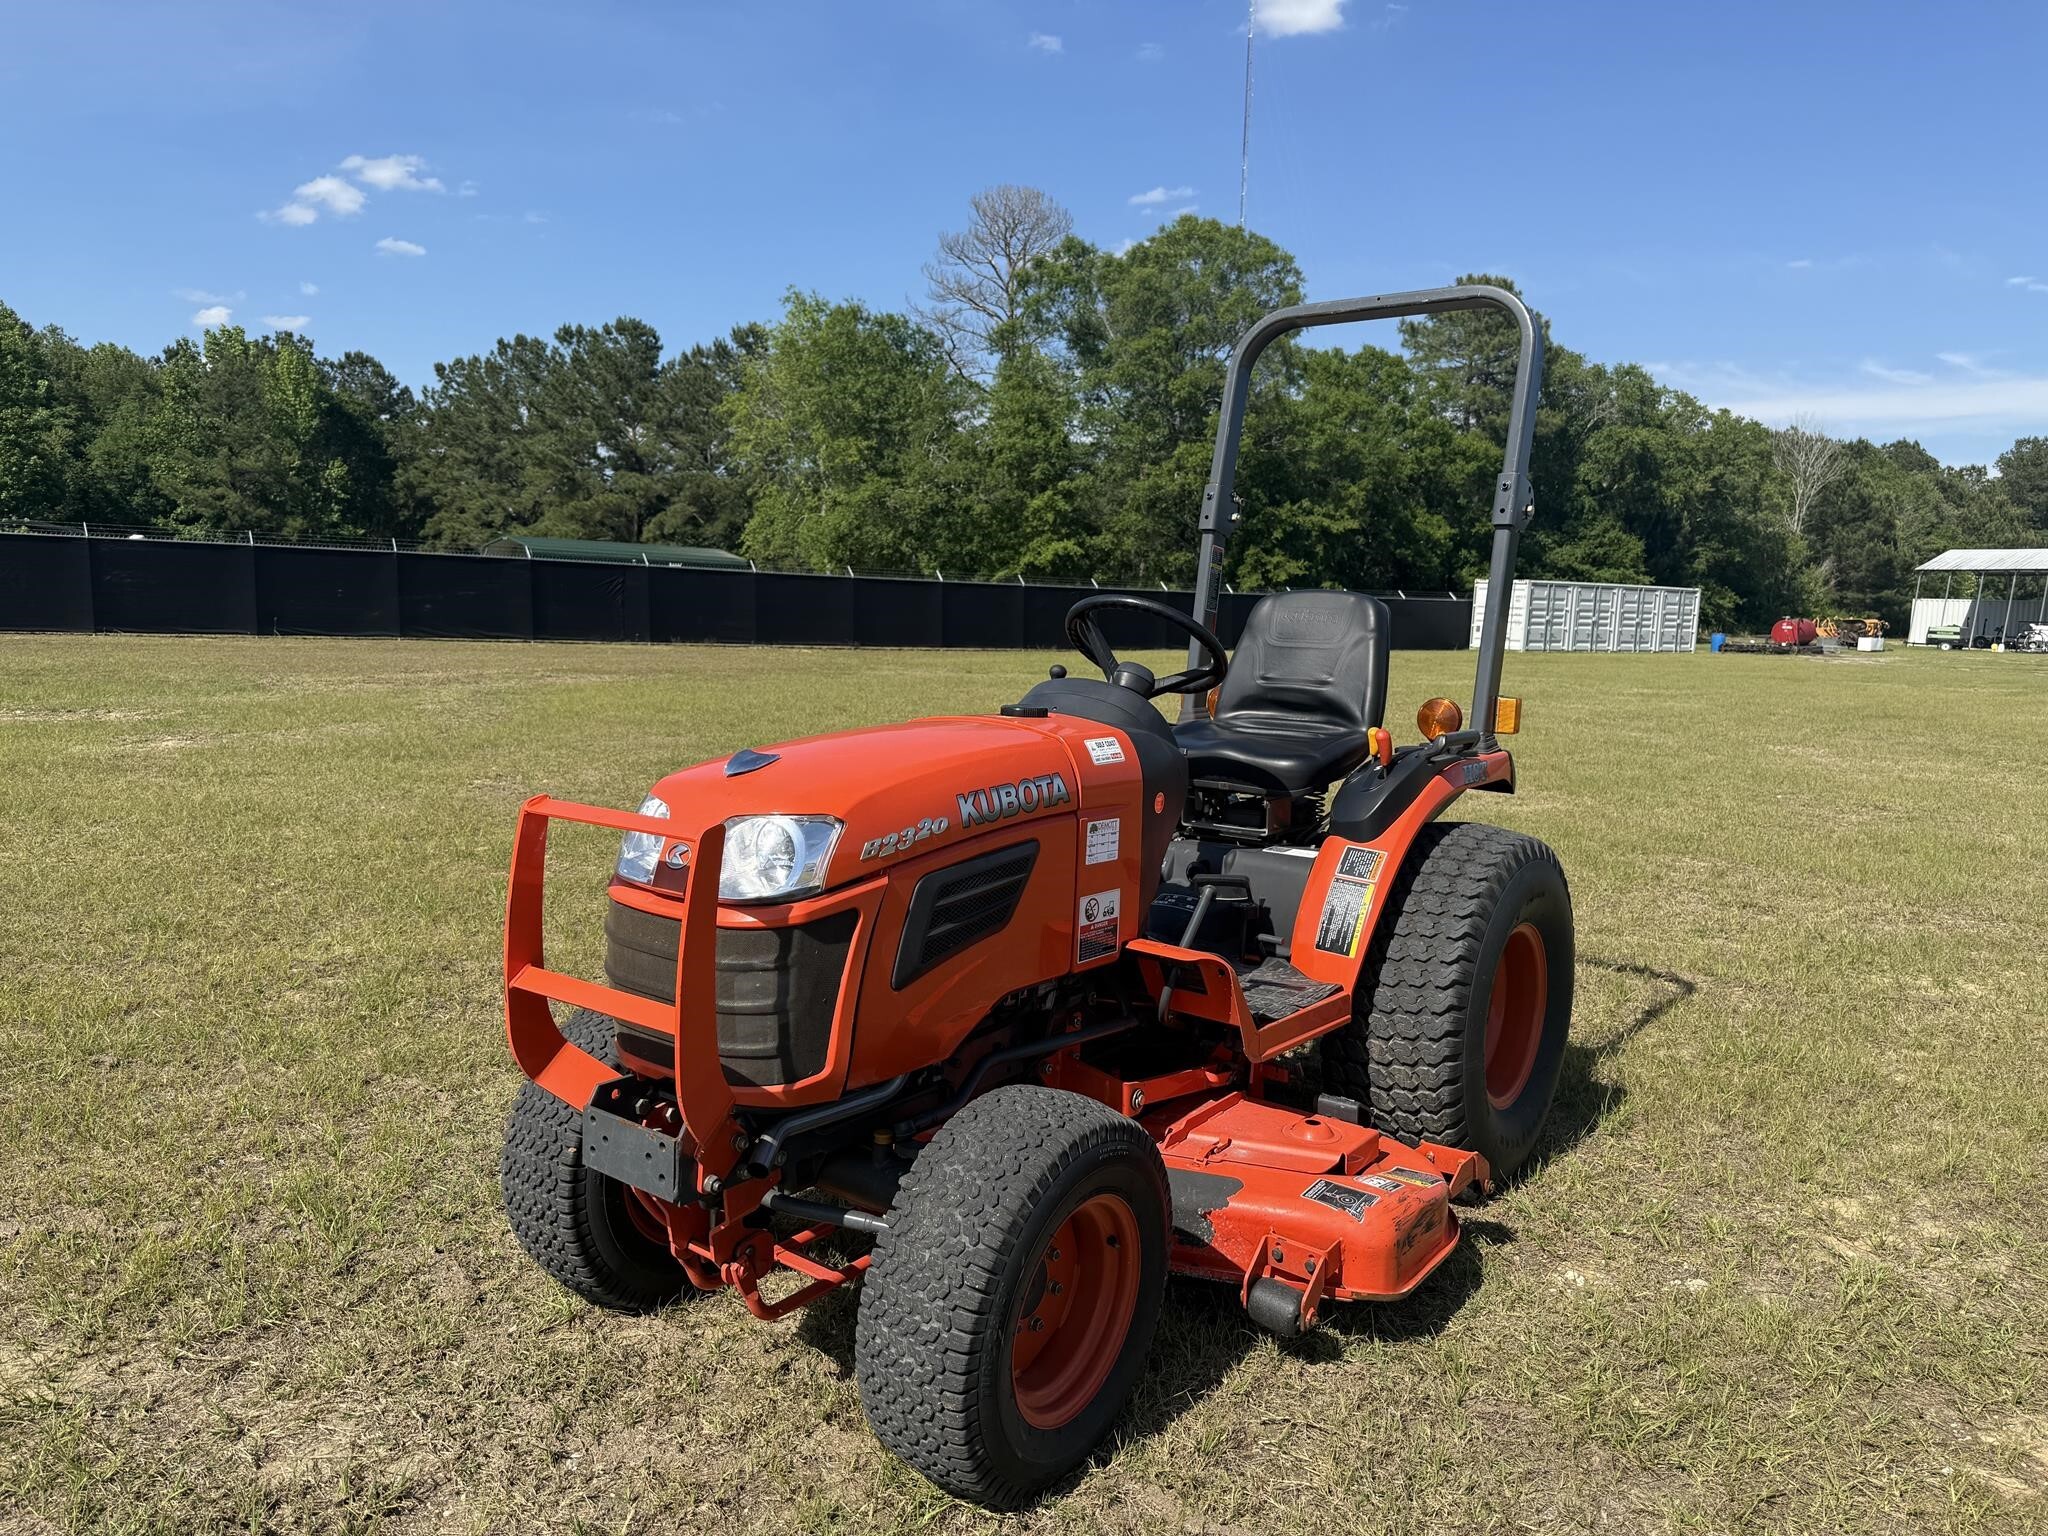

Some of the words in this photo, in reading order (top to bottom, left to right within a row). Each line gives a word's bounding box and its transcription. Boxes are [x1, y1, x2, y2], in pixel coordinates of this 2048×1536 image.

[1462, 761, 1488, 784] HST
[956, 772, 1070, 828] KUBOTA
[860, 816, 949, 860] B2320
